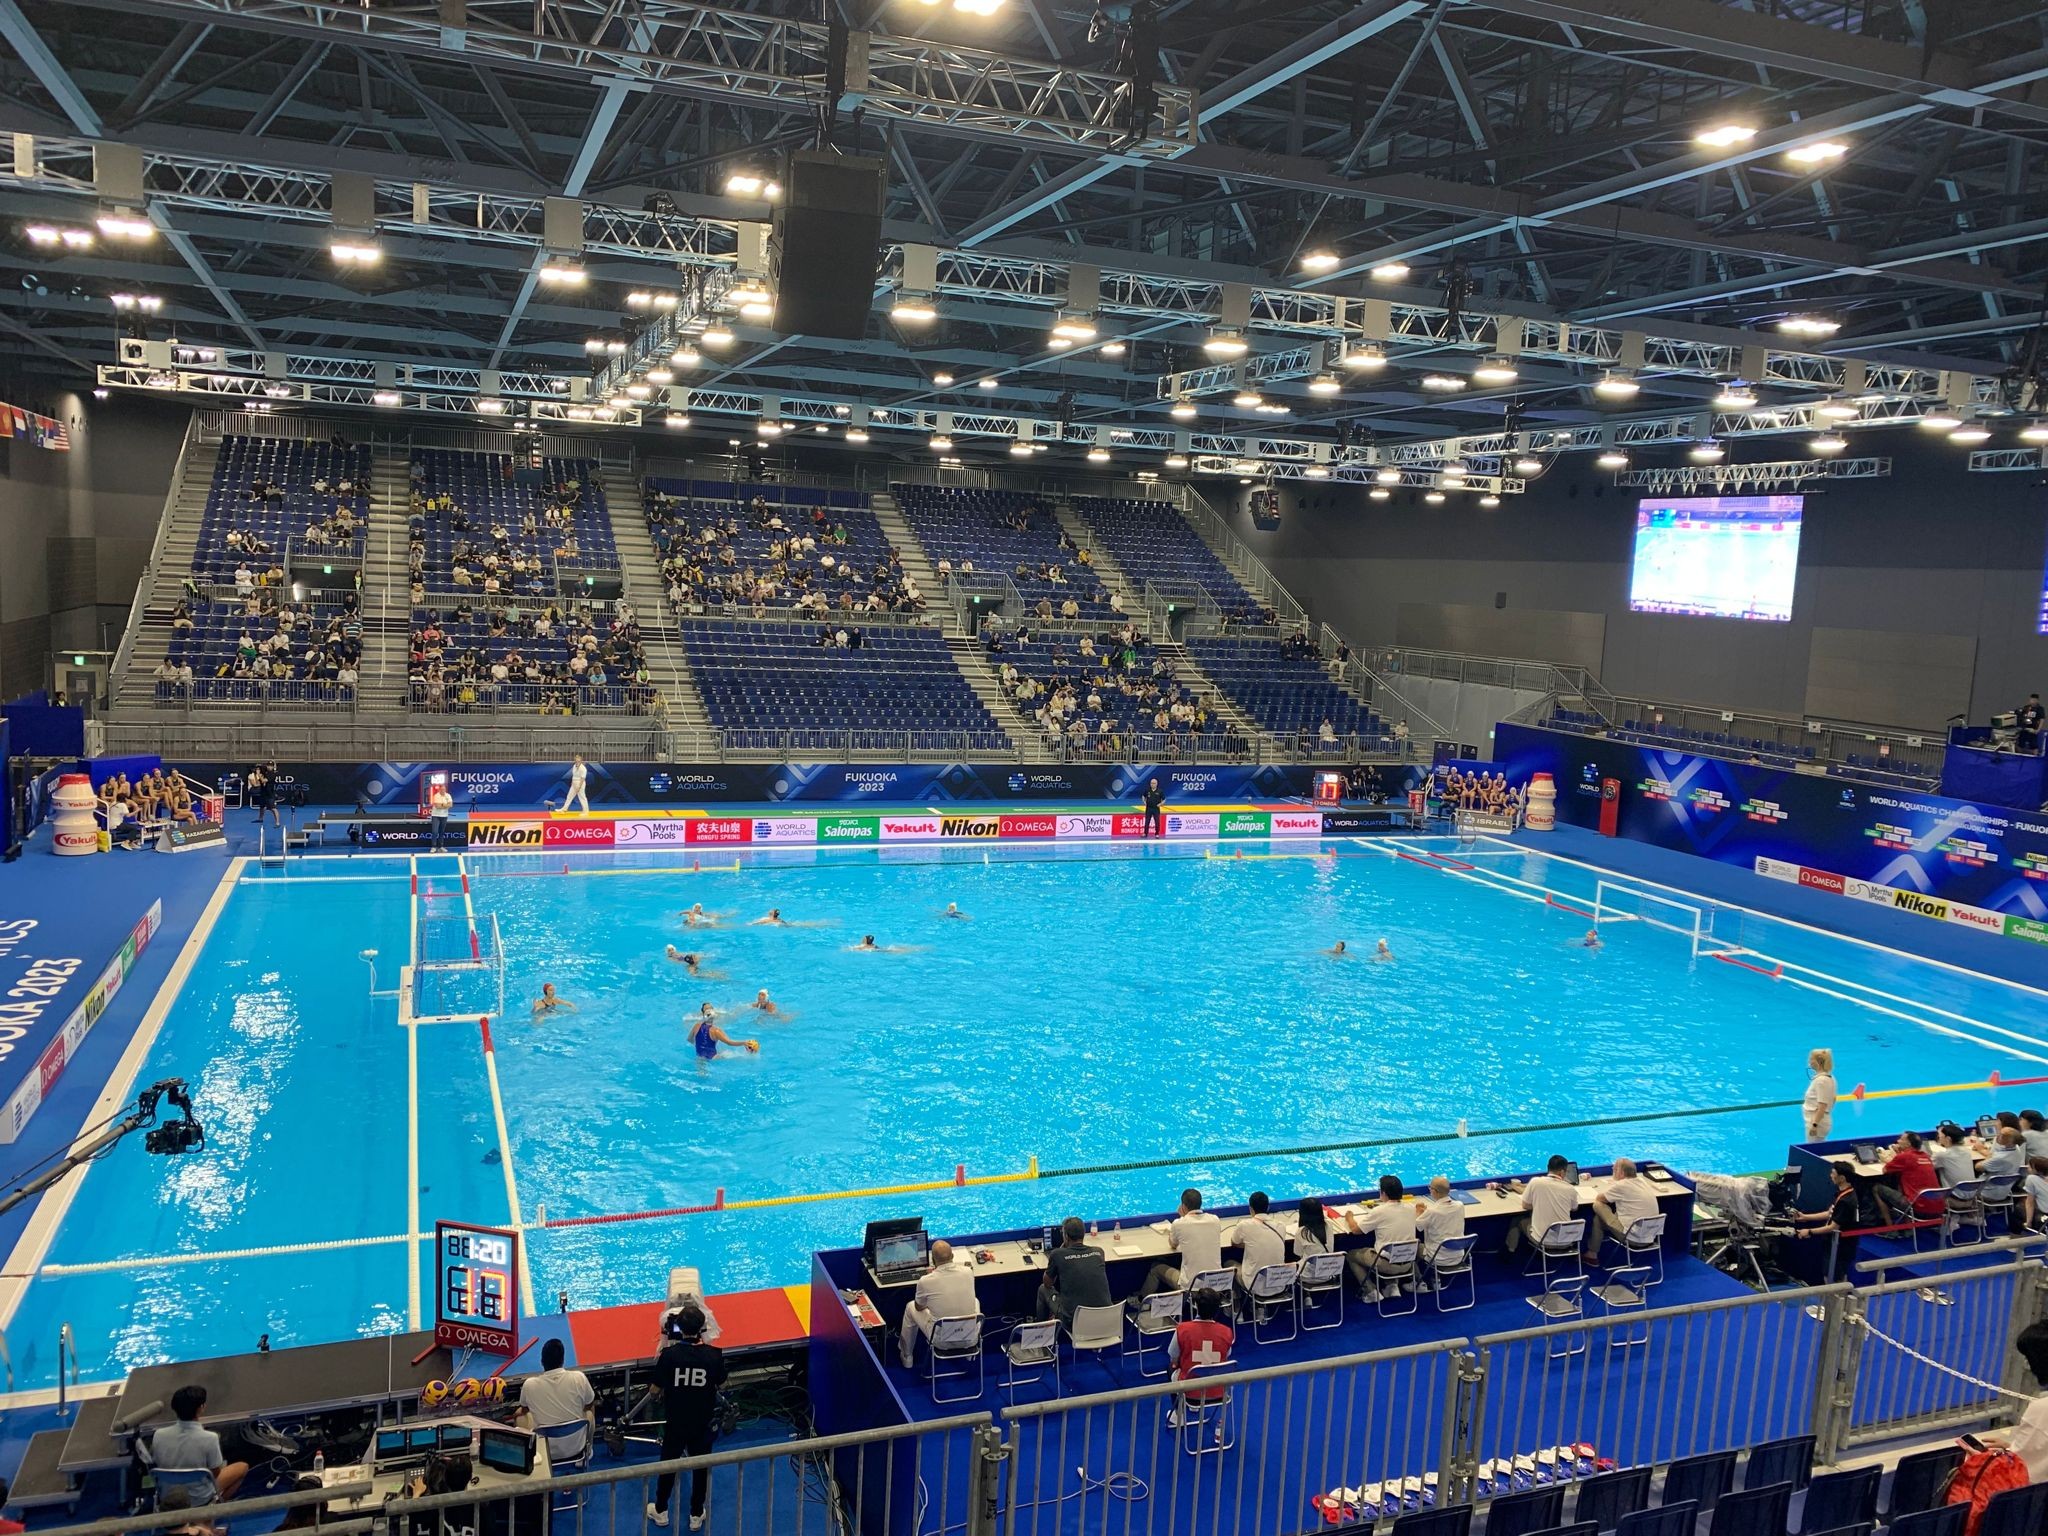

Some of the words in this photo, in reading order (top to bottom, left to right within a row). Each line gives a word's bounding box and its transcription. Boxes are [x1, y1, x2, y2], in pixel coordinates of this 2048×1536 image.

[451, 773, 514, 783] FUKUOKA
[676, 775, 714, 783] WORLD
[845, 773, 898, 782] FUKUOKA
[1171, 773, 1217, 782] FUKUOKA
[467, 784, 499, 794] 2023
[677, 782, 727, 790] AQUATICS
[858, 783, 885, 792] 2023
[1182, 782, 1205, 791] 2023
[1578, 783, 1600, 792] WORLD
[1869, 795, 1898, 808] WORLD
[1898, 801, 1938, 815] AQUATICS
[1938, 808, 2009, 828] CHAMPIONSHIPS
[652, 823, 684, 832] Myrtha
[1015, 822, 1054, 832] OMEGA
[1086, 818, 1111, 827] Myrtha
[1224, 821, 1265, 834] Salonpas
[1274, 819, 1319, 829] Yakult
[1476, 818, 1510, 828] ISRAEL
[185, 827, 221, 838] KAZAKHSTAN
[696, 822, 741, 834] 农夫山泉
[776, 829, 816, 837] AQUATICS
[823, 825, 873, 839] Salonpas
[884, 823, 937, 833] Yakult
[941, 819, 999, 837] Nikon
[1086, 825, 1105, 833] Pools
[382, 832, 418, 840] WORLD
[469, 824, 542, 845] Nikon
[563, 828, 613, 839] OMEGA
[652, 831, 676, 840] Pools
[63, 833, 97, 845] Yakult
[1771, 863, 1792, 874] WORLD
[1811, 876, 1843, 890] OMEGA
[1871, 885, 1893, 897] Myrtha
[1870, 893, 1888, 903] Pools
[1894, 892, 1947, 918] Nikon
[1951, 907, 2001, 928] Yakult
[7, 958, 83, 998] 2023
[84, 988, 106, 1031] Nikon
[47, 1049, 64, 1080] OMEGA
[1064, 1253, 1081, 1261] WORLD
[455, 1327, 510, 1349] OMEGA
[673, 1366, 708, 1388] HB
